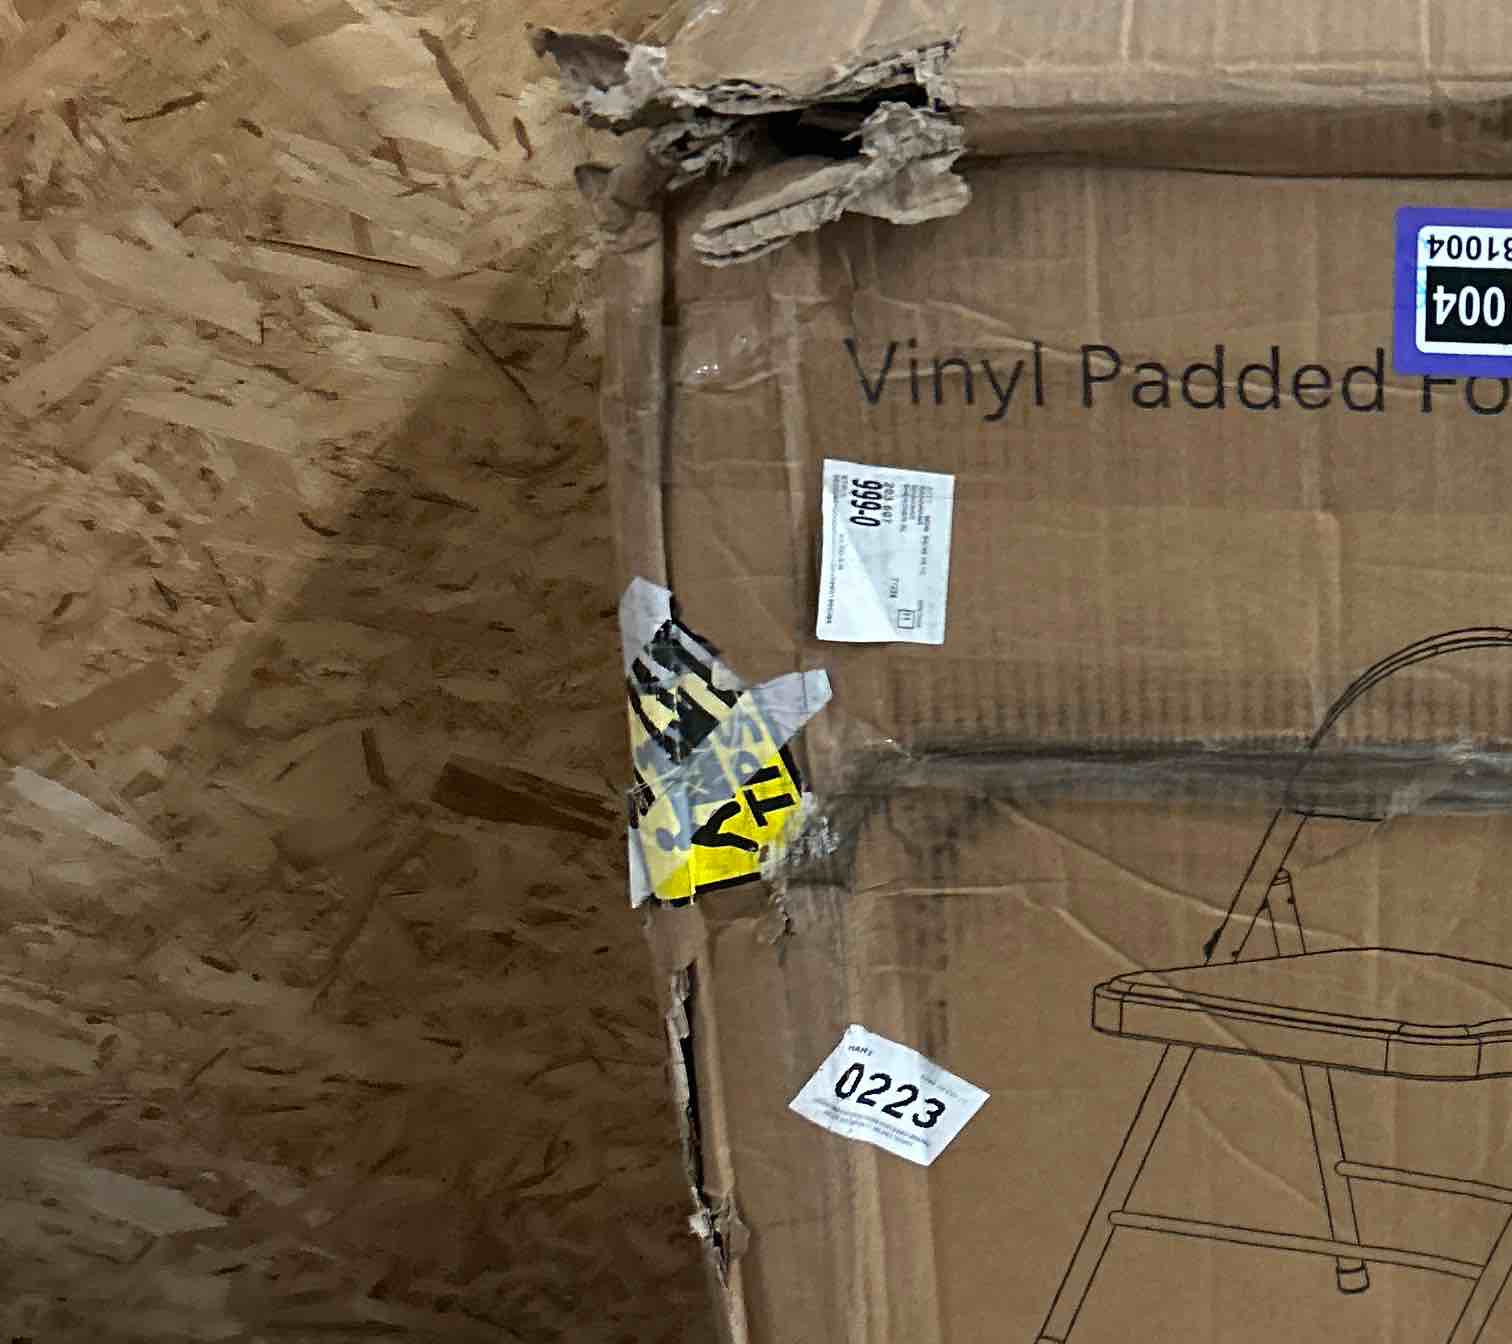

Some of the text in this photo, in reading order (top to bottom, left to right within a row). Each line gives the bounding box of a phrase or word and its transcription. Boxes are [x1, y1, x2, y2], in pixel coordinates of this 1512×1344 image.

[842, 337, 1045, 422] Vinyl
[1079, 343, 1387, 413] Padded
[849, 478, 884, 527] 999-0
[834, 1062, 946, 1129] 0223
